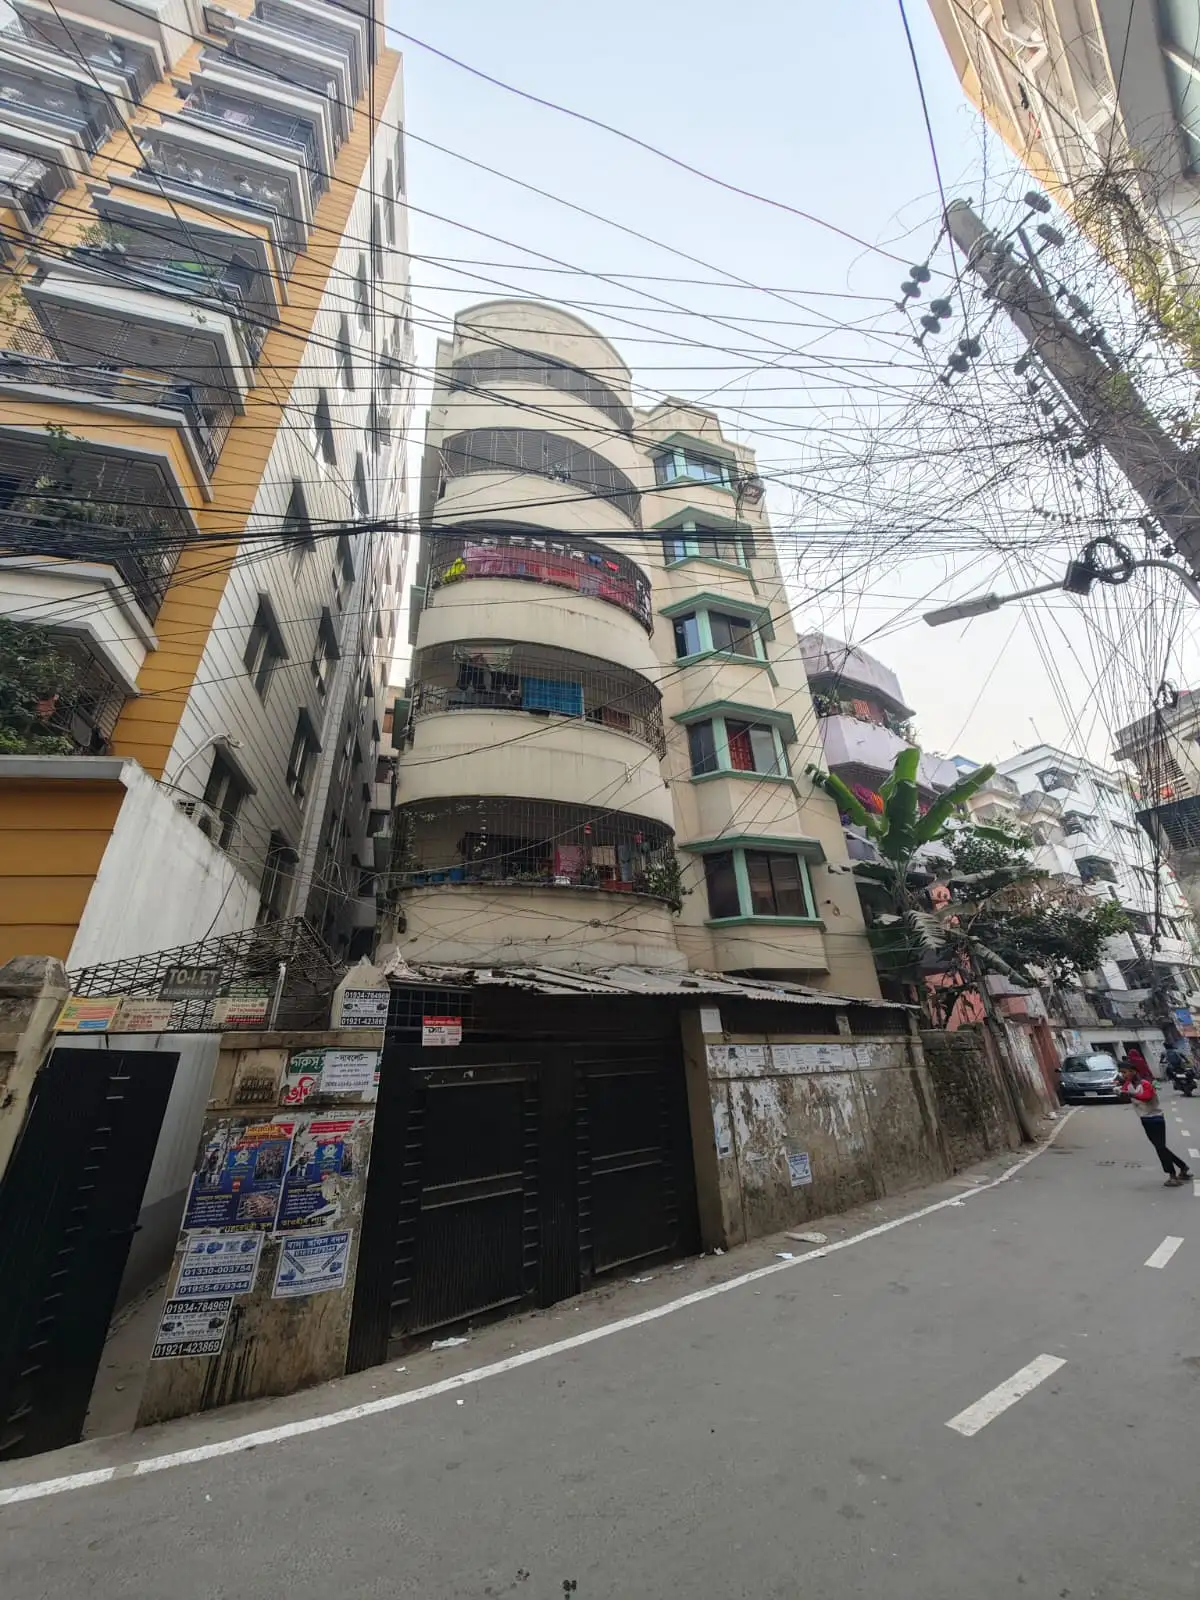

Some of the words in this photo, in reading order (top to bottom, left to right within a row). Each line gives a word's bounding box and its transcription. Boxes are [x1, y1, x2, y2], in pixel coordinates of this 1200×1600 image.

[168, 969, 219, 985] TO-LET
[166, 1300, 230, 1314] 01934-784969
[153, 1340, 220, 1356] 01921-423869
